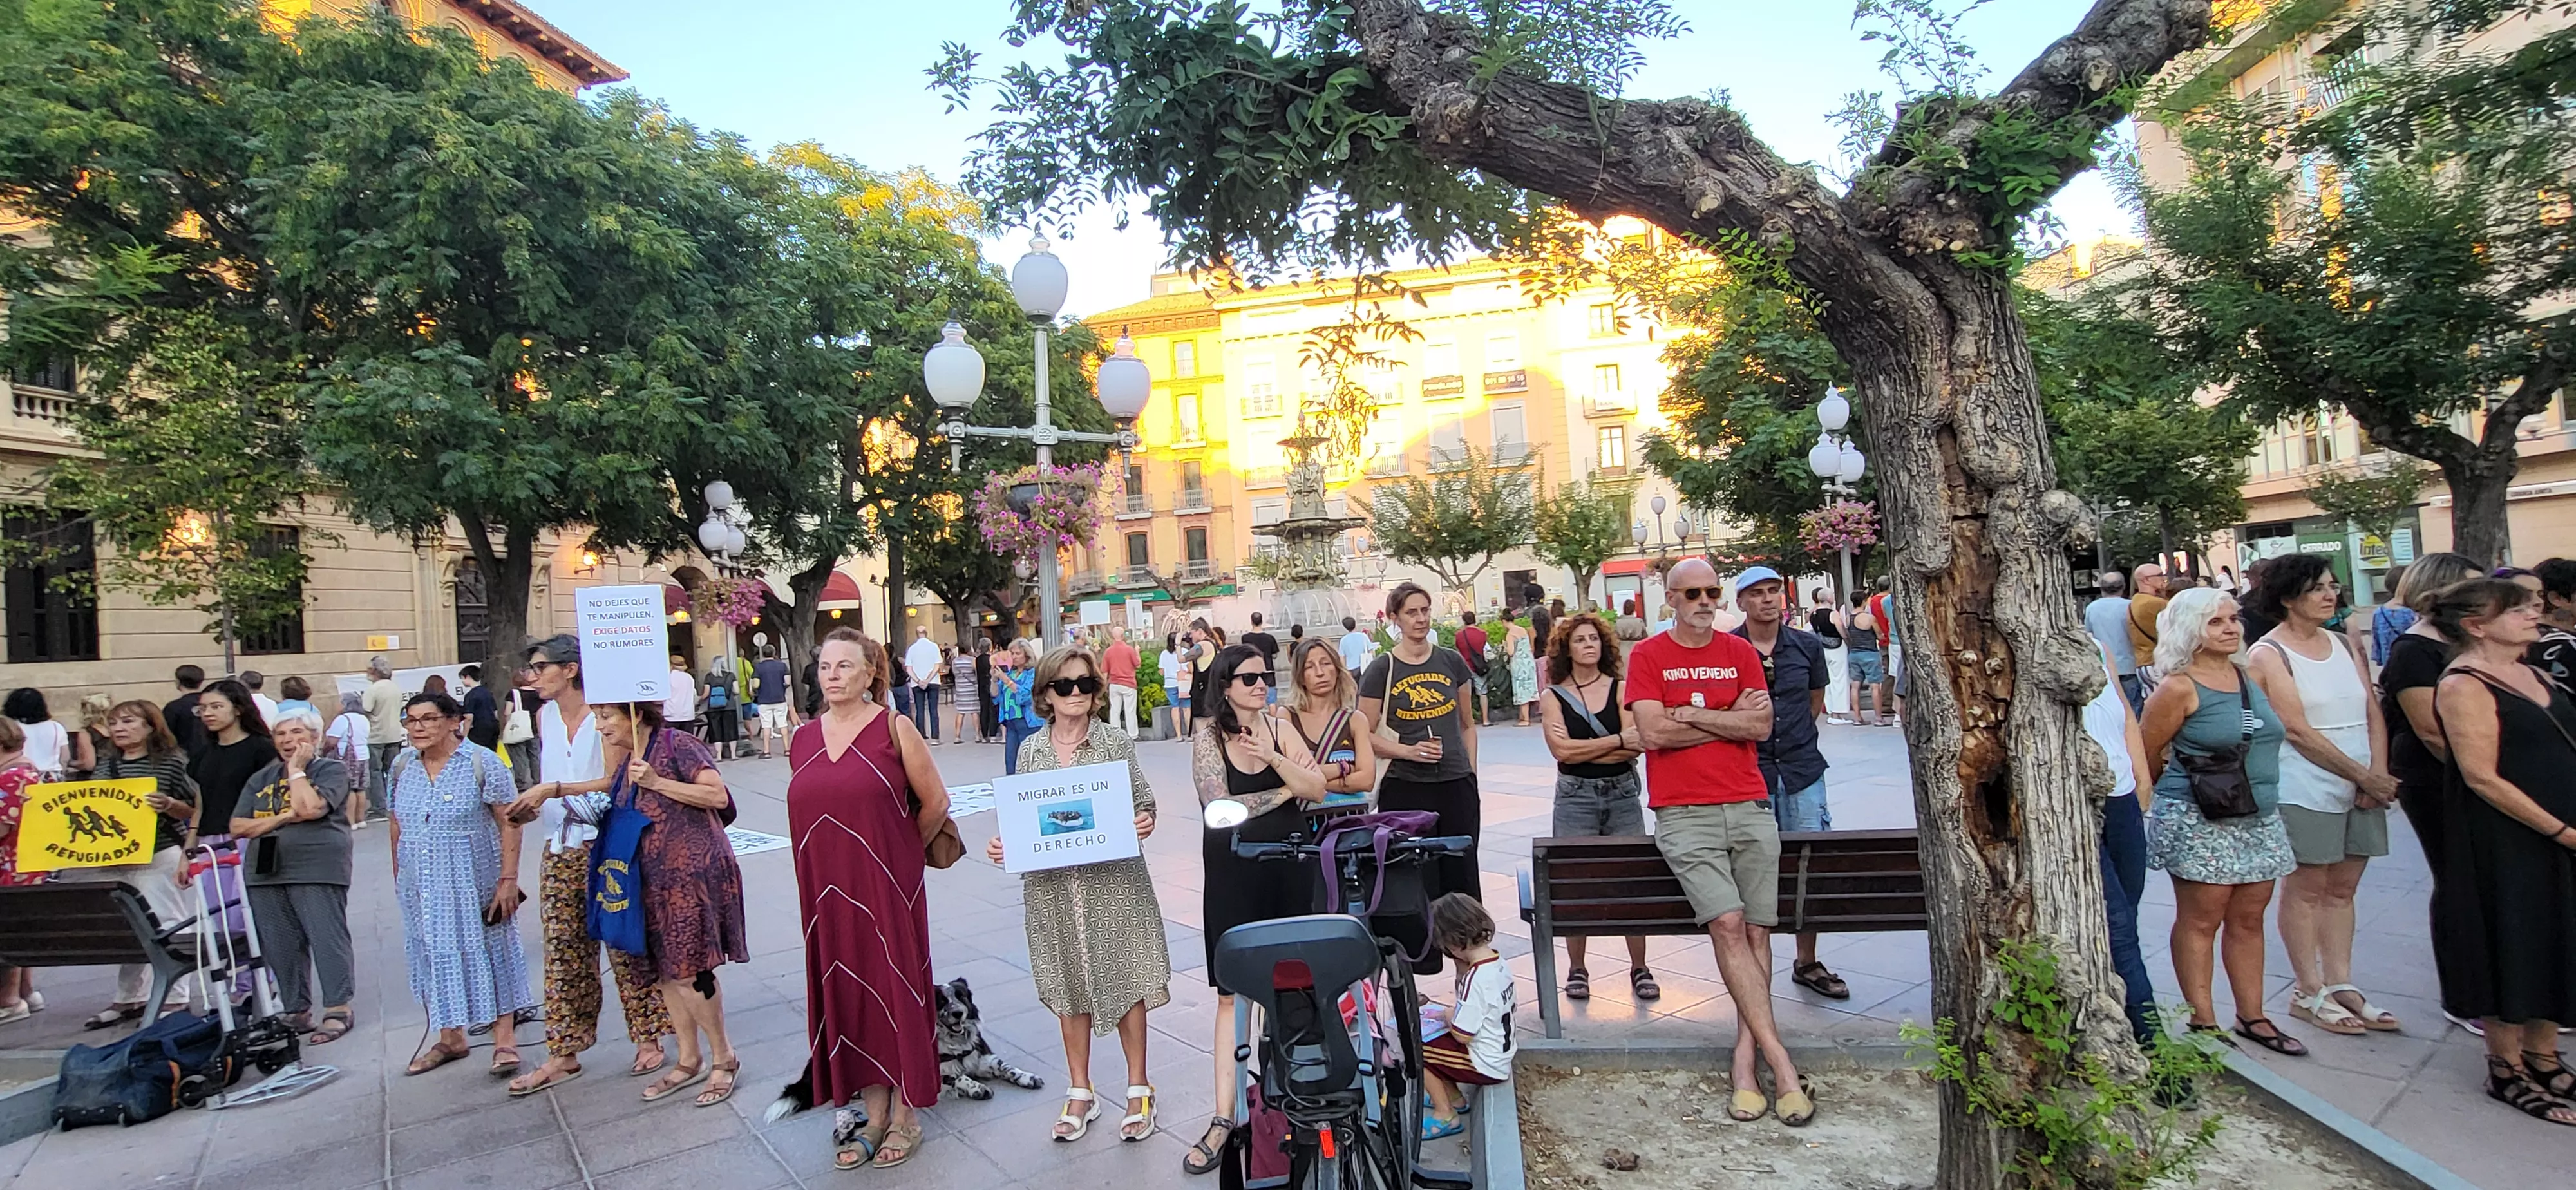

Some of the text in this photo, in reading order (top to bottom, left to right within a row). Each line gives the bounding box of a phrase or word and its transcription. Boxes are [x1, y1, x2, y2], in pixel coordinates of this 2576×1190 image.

[2300, 541, 2342, 552] CERRADO
[631, 598, 650, 607] QUE
[600, 611, 654, 620] MANIPULEN.
[610, 639, 654, 648] RUMORES
[1663, 666, 1738, 681] KIKO VENENO
[1391, 673, 1452, 696] REFUGIADXS
[1018, 780, 1109, 802] MIGRAR ES UN
[42, 788, 143, 813] BIENVENIDXS
[45, 839, 140, 863] REFUGIADXS
[1033, 834, 1106, 853] DERECHO
